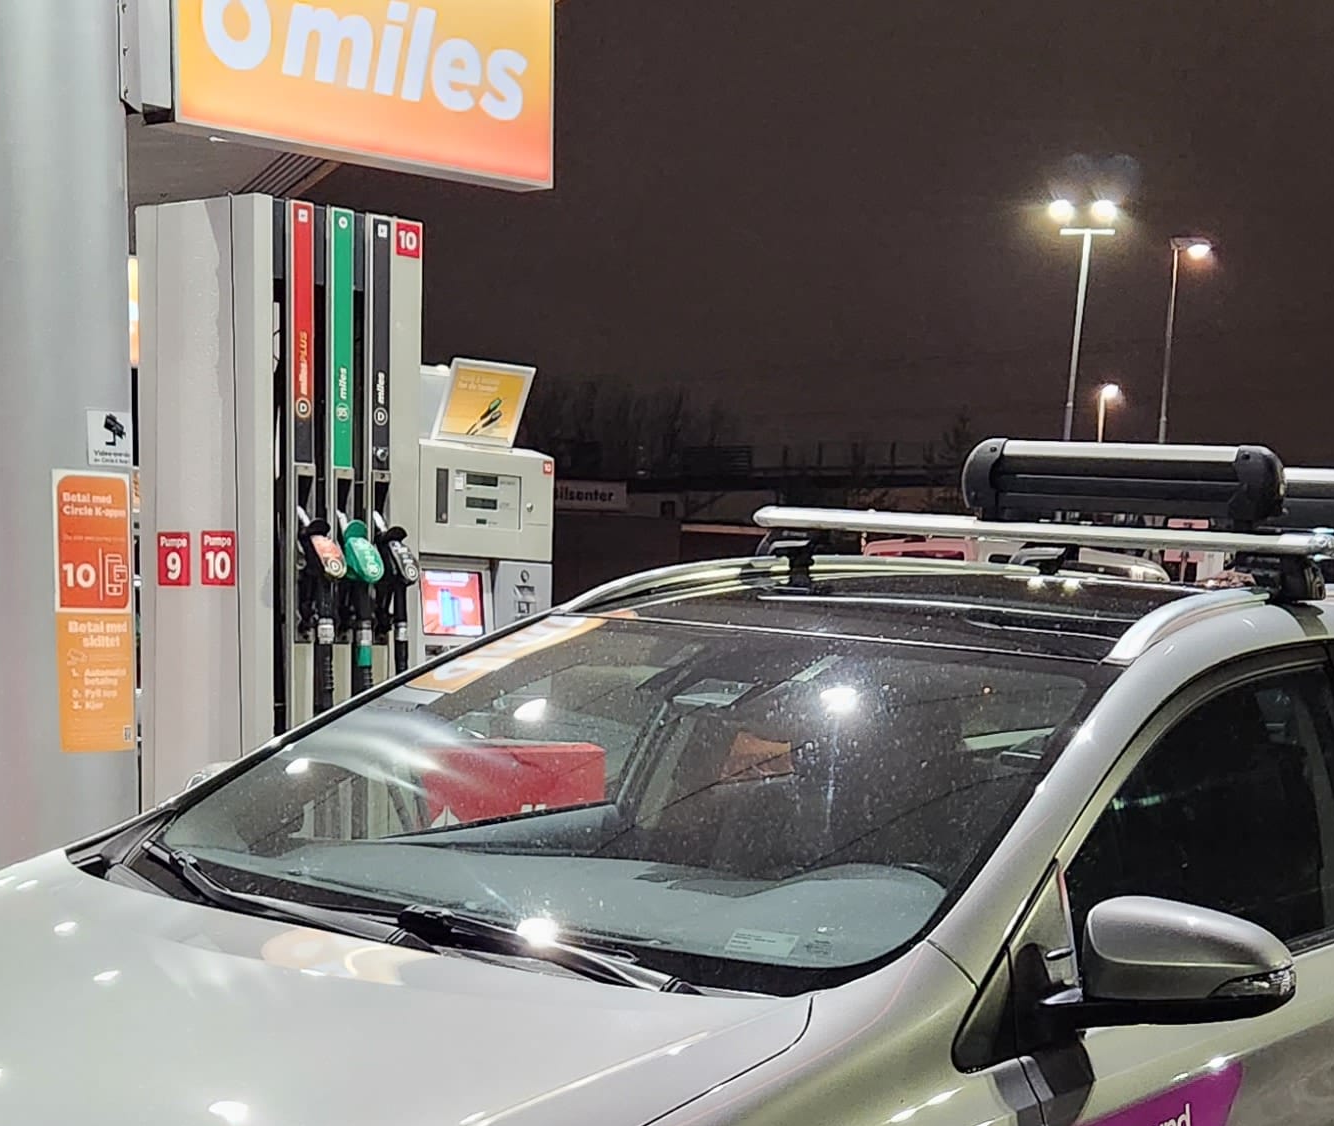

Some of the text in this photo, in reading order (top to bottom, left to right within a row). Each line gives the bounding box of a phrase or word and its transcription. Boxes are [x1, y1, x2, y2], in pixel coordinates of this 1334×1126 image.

[281, 0, 528, 121] miles
[398, 230, 417, 251] 10
[339, 367, 348, 400] miles
[376, 371, 385, 405] miles
[62, 491, 90, 503] Betal
[62, 505, 93, 517] Circle
[62, 562, 97, 588] 10
[166, 551, 182, 581] 9
[205, 551, 231, 580] 10
